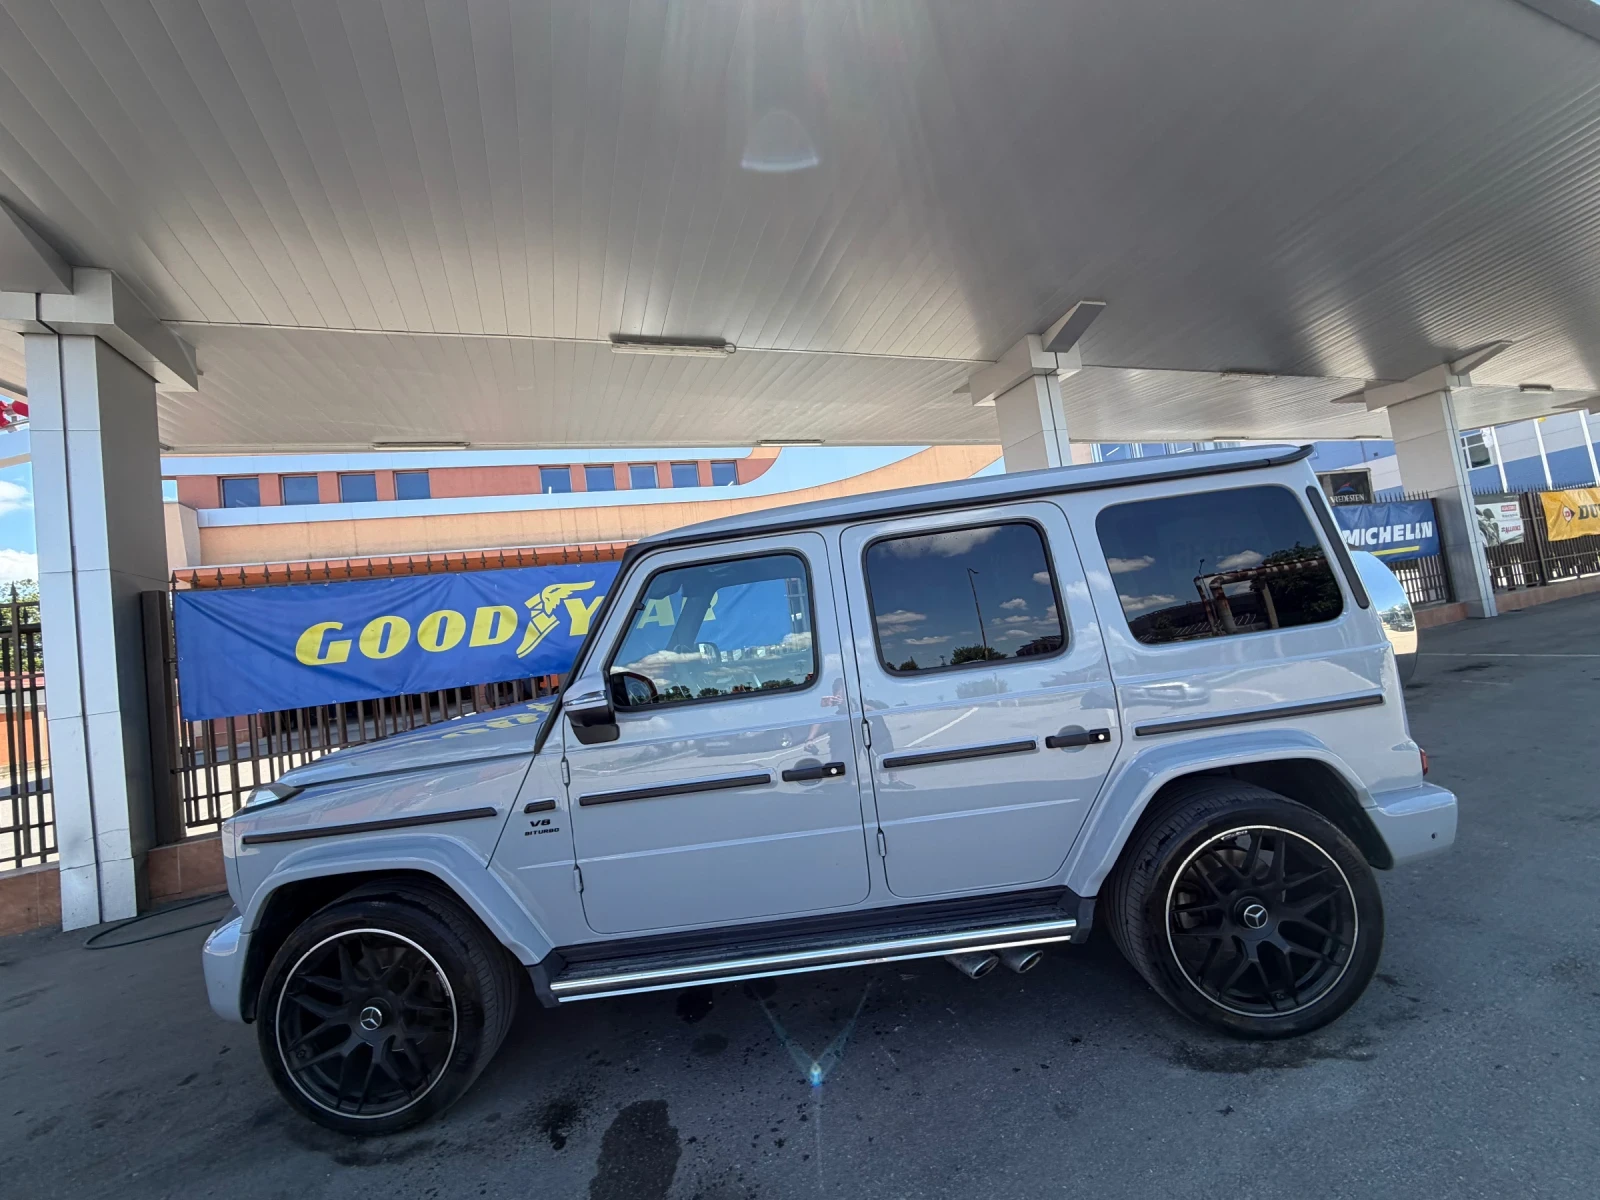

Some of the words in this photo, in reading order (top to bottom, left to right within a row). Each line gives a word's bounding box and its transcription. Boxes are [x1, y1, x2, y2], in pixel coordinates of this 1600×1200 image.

[1578, 504, 1600, 520] DU
[1342, 521, 1433, 546] MICHELIN
[295, 590, 719, 667] GOODYA
[530, 819, 551, 827] V8
[524, 827, 560, 836] BITURBO
